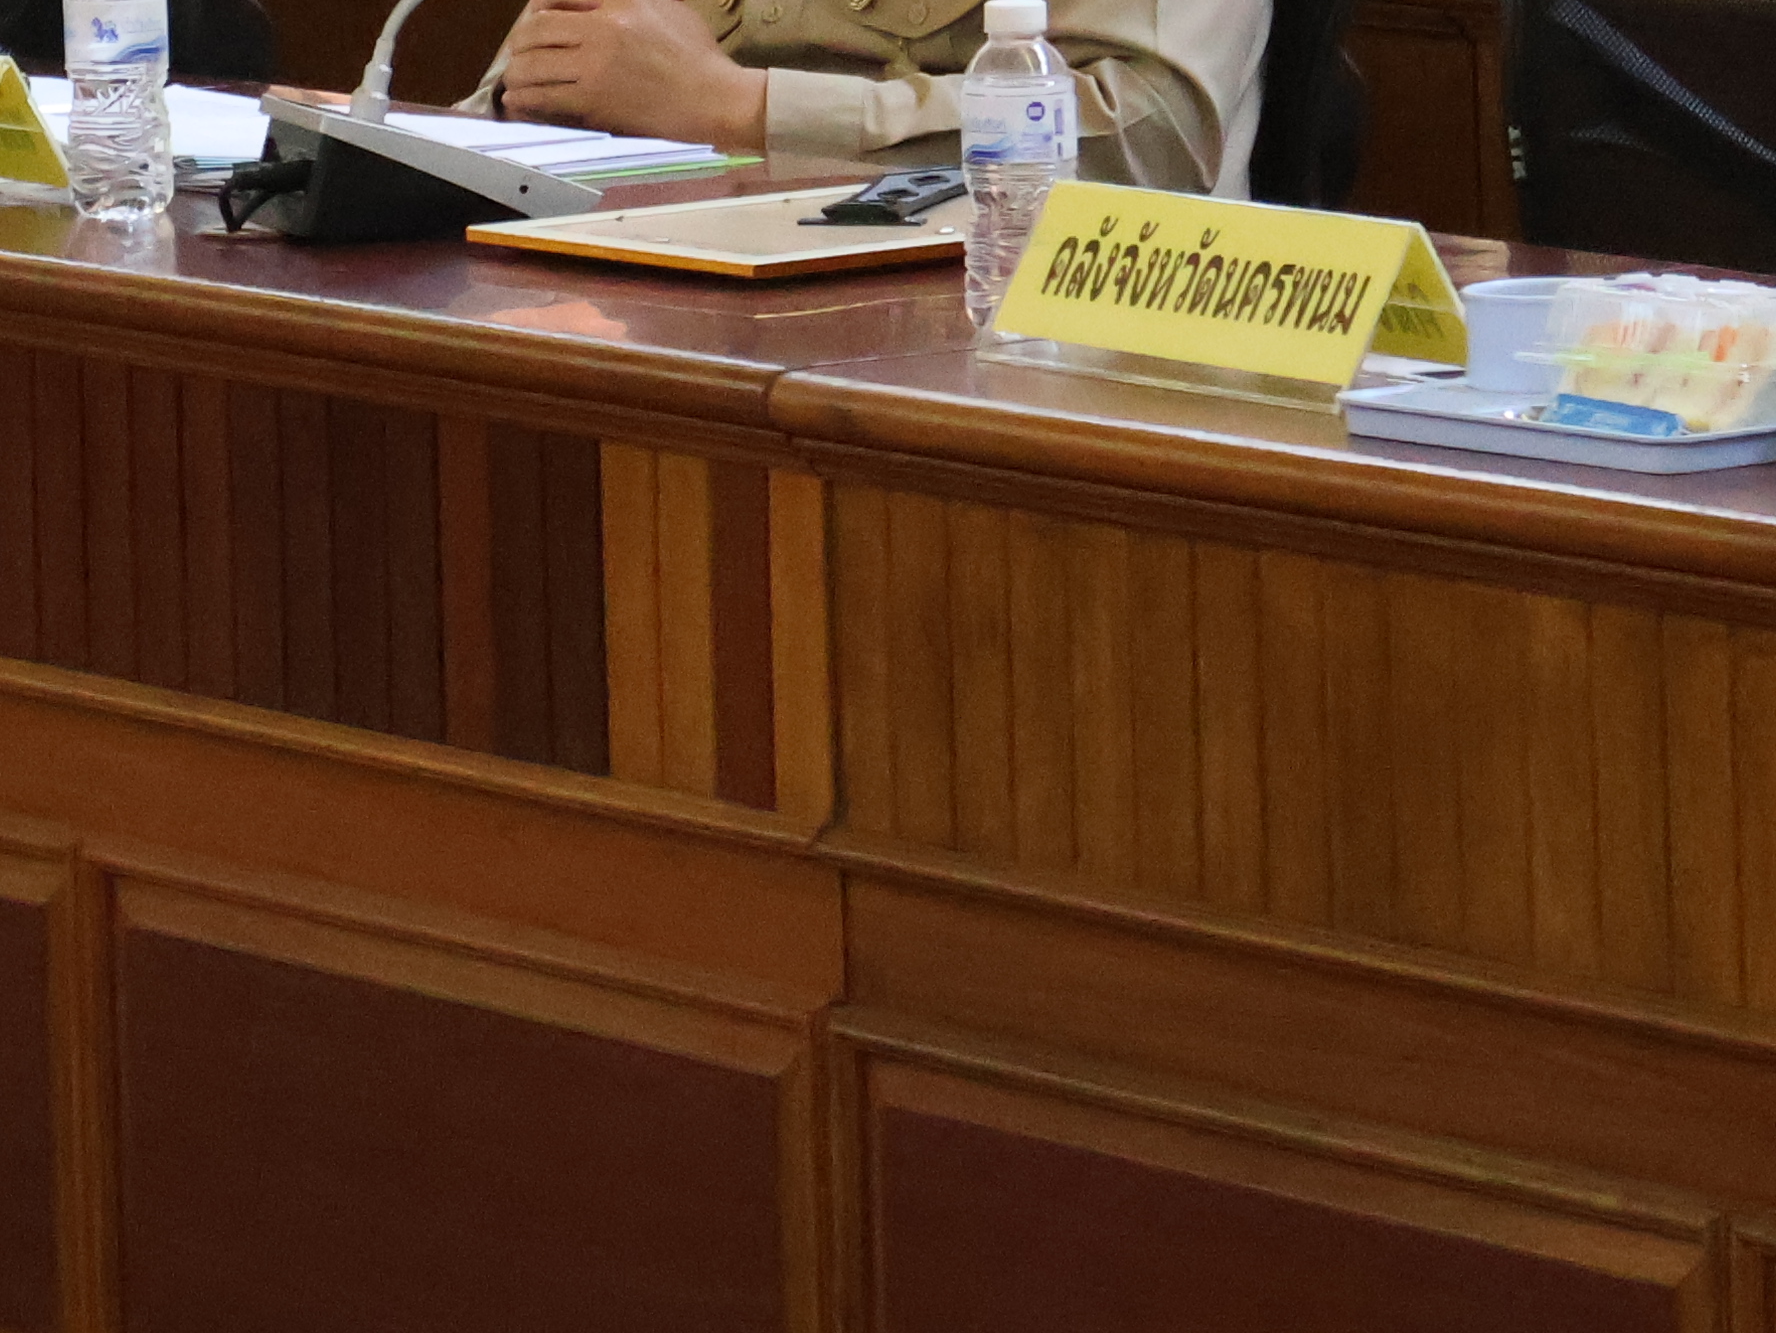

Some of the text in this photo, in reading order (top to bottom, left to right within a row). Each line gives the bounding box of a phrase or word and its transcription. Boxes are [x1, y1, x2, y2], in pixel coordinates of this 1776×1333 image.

[1041, 215, 1371, 335] คลังจังหวัดนครพนม
